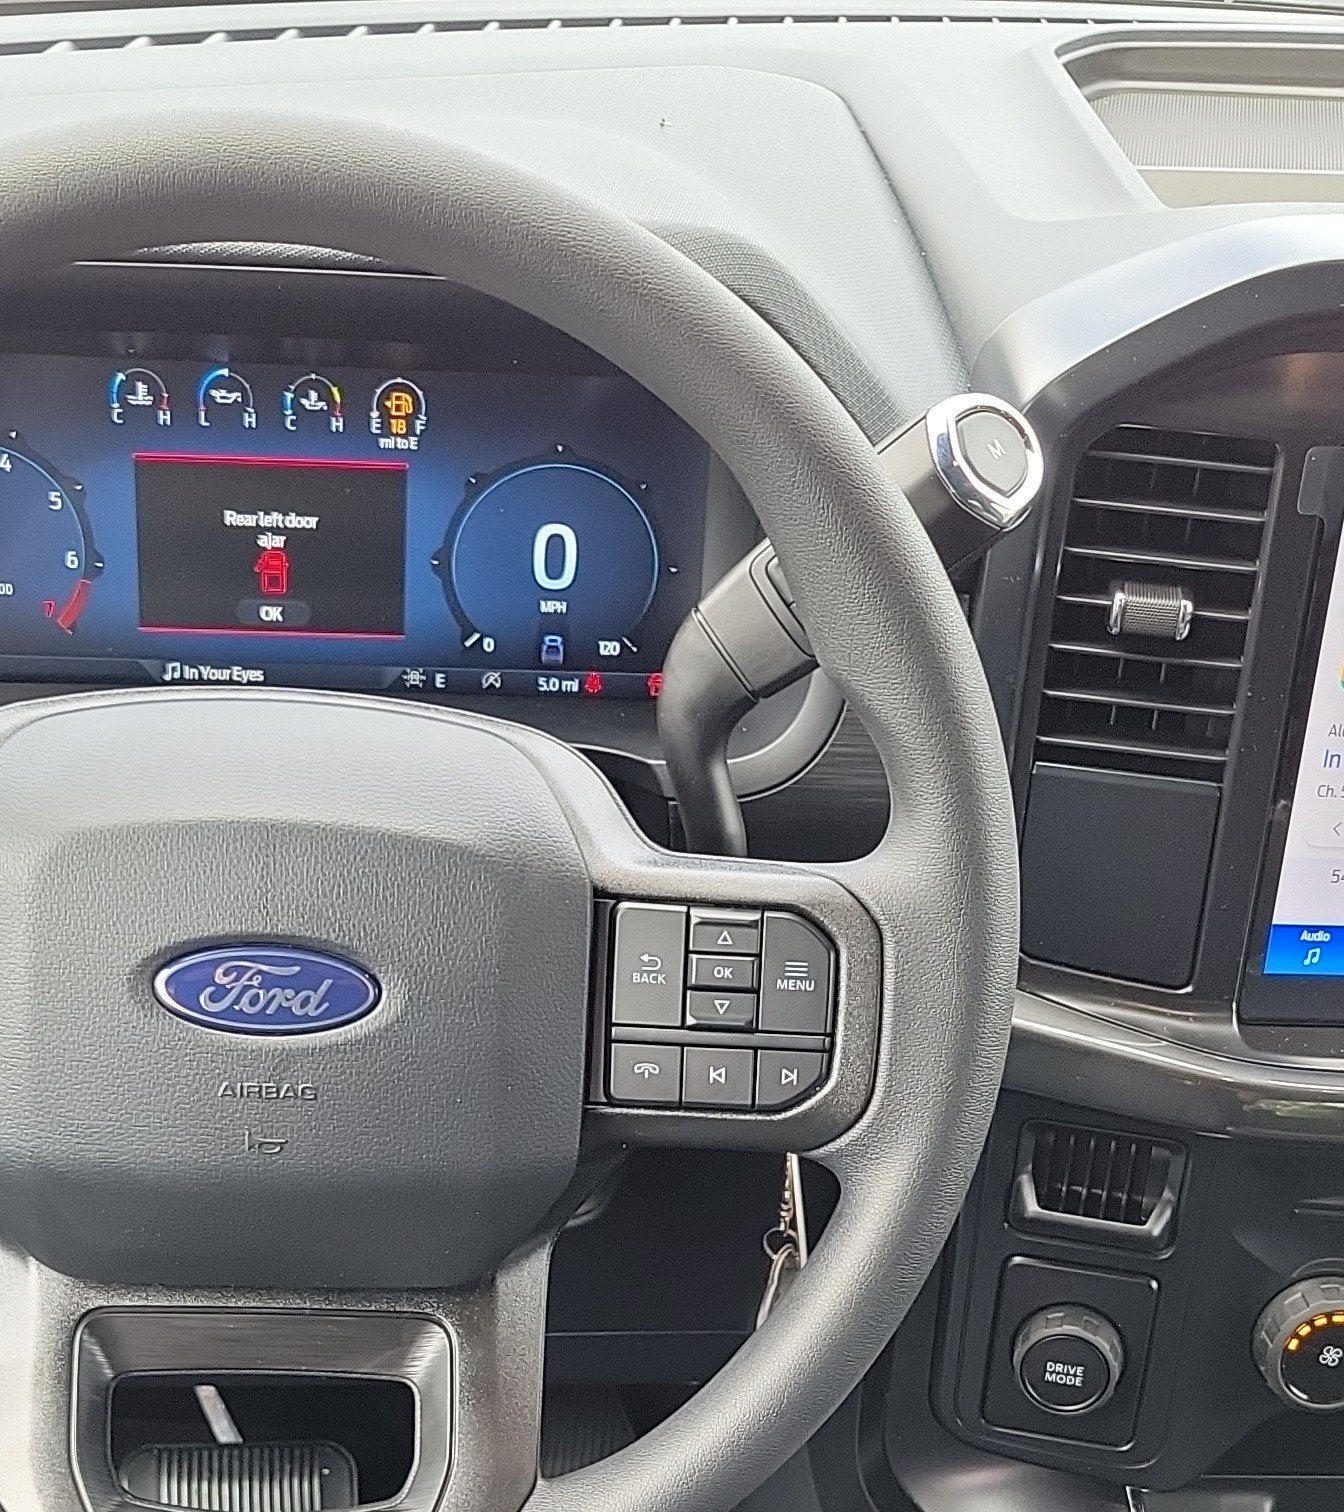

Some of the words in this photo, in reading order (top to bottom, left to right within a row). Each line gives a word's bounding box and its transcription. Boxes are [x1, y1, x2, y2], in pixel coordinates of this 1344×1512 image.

[111, 408, 124, 424] C
[157, 410, 171, 426] H
[199, 411, 210, 426] L
[243, 412, 256, 429] H
[284, 415, 297, 430] C
[330, 417, 344, 432] H
[370, 419, 381, 434] E
[414, 420, 426, 435] F
[409, 437, 419, 450] E
[48, 491, 62, 510] 5
[224, 510, 258, 527] Rear
[258, 511, 284, 528] left
[285, 512, 319, 529] door
[257, 532, 286, 550] ajar
[65, 551, 79, 569] 6
[533, 522, 578, 590] 0
[43, 600, 55, 618] 7
[259, 606, 283, 622] OK
[539, 600, 568, 614] MPH
[482, 637, 495, 652] 0
[598, 640, 621, 656] 120
[183, 665, 199, 680] In
[199, 666, 232, 682] Your
[231, 667, 264, 683] Eyes
[435, 673, 447, 688] E
[537, 677, 557, 692] 5.0
[561, 678, 580, 692] mi
[1323, 749, 1341, 768] In
[1317, 785, 1337, 799] Ch.
[1300, 930, 1331, 942] Audio
[632, 973, 666, 985] BACK
[713, 967, 733, 979] OK
[199, 960, 333, 1016] Ford
[776, 978, 815, 991] MENU
[218, 1081, 318, 1100] AIRBAG
[1046, 1361, 1085, 1376] DRIVE
[1044, 1372, 1084, 1387] MODE
